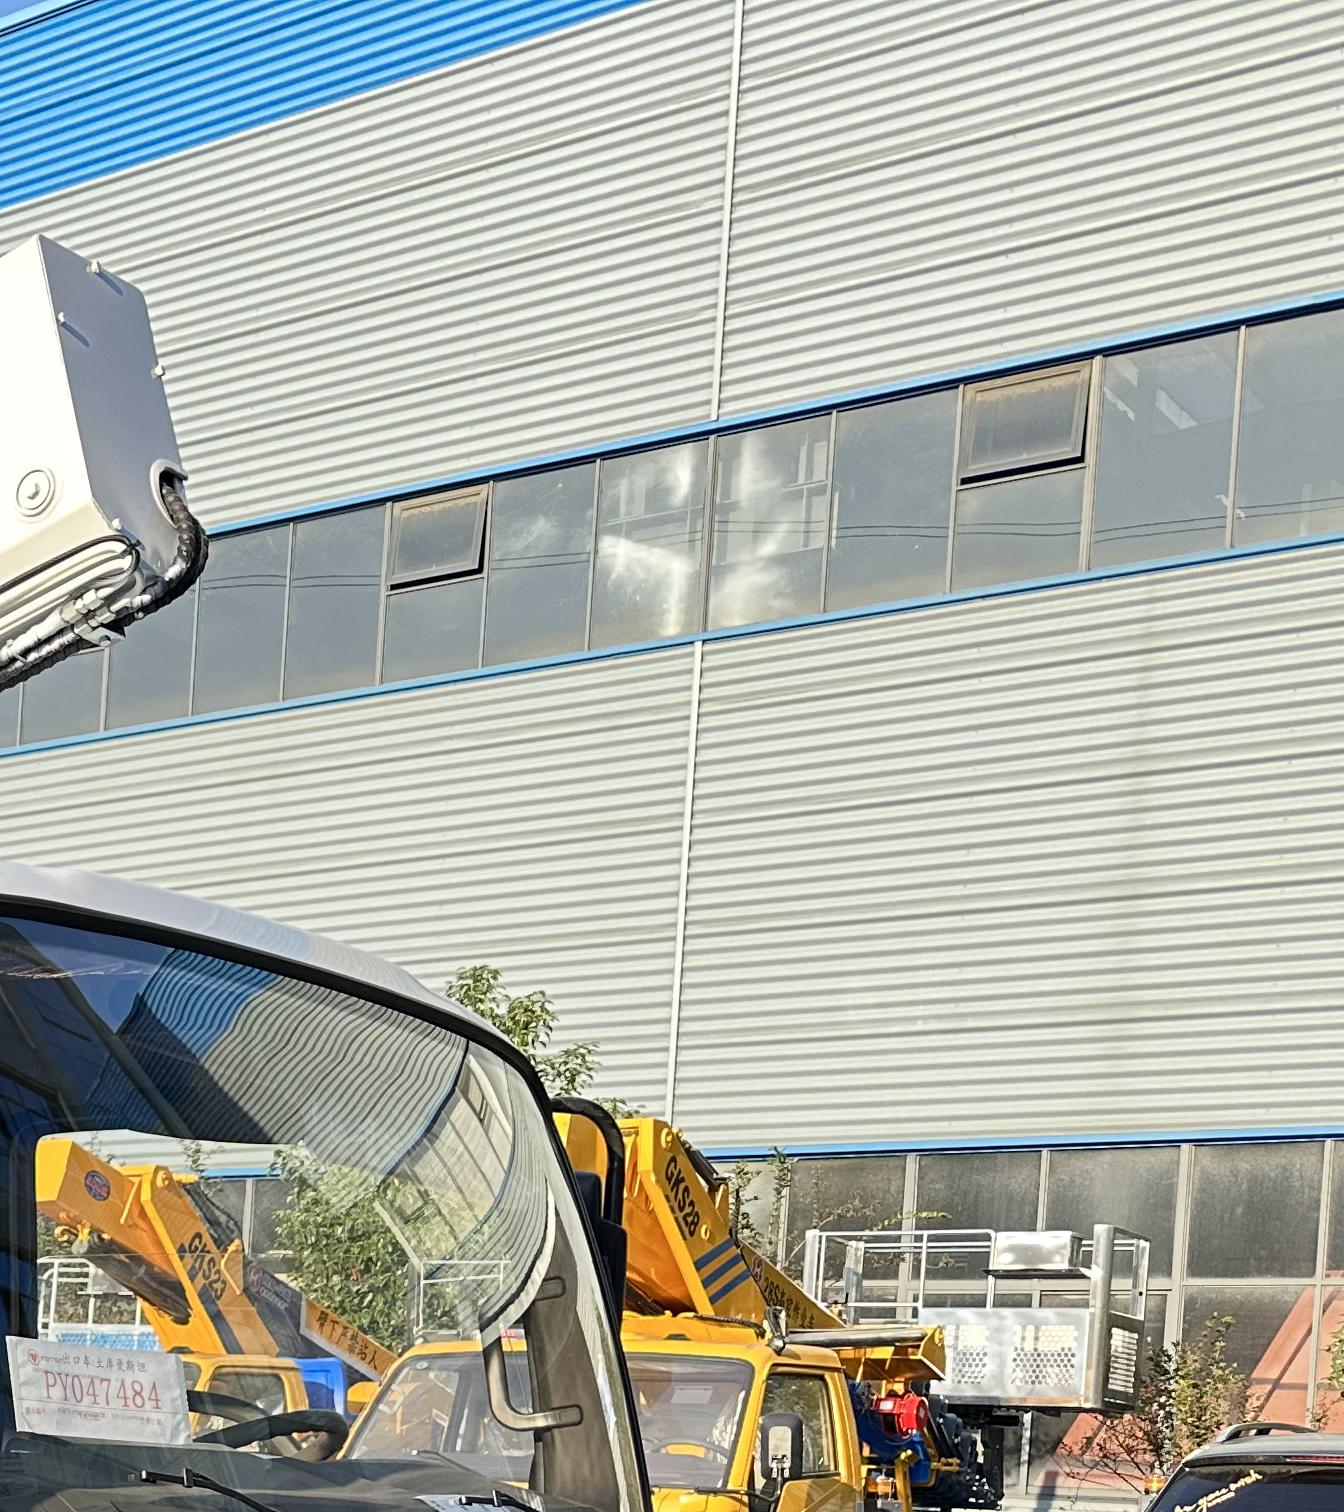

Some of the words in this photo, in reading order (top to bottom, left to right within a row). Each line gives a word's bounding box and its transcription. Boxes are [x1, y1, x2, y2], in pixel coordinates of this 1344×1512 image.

[664, 1155, 700, 1237] GKS28
[316, 1310, 378, 1371] 臂下严禁站人
[44, 1371, 162, 1410] PY047484
